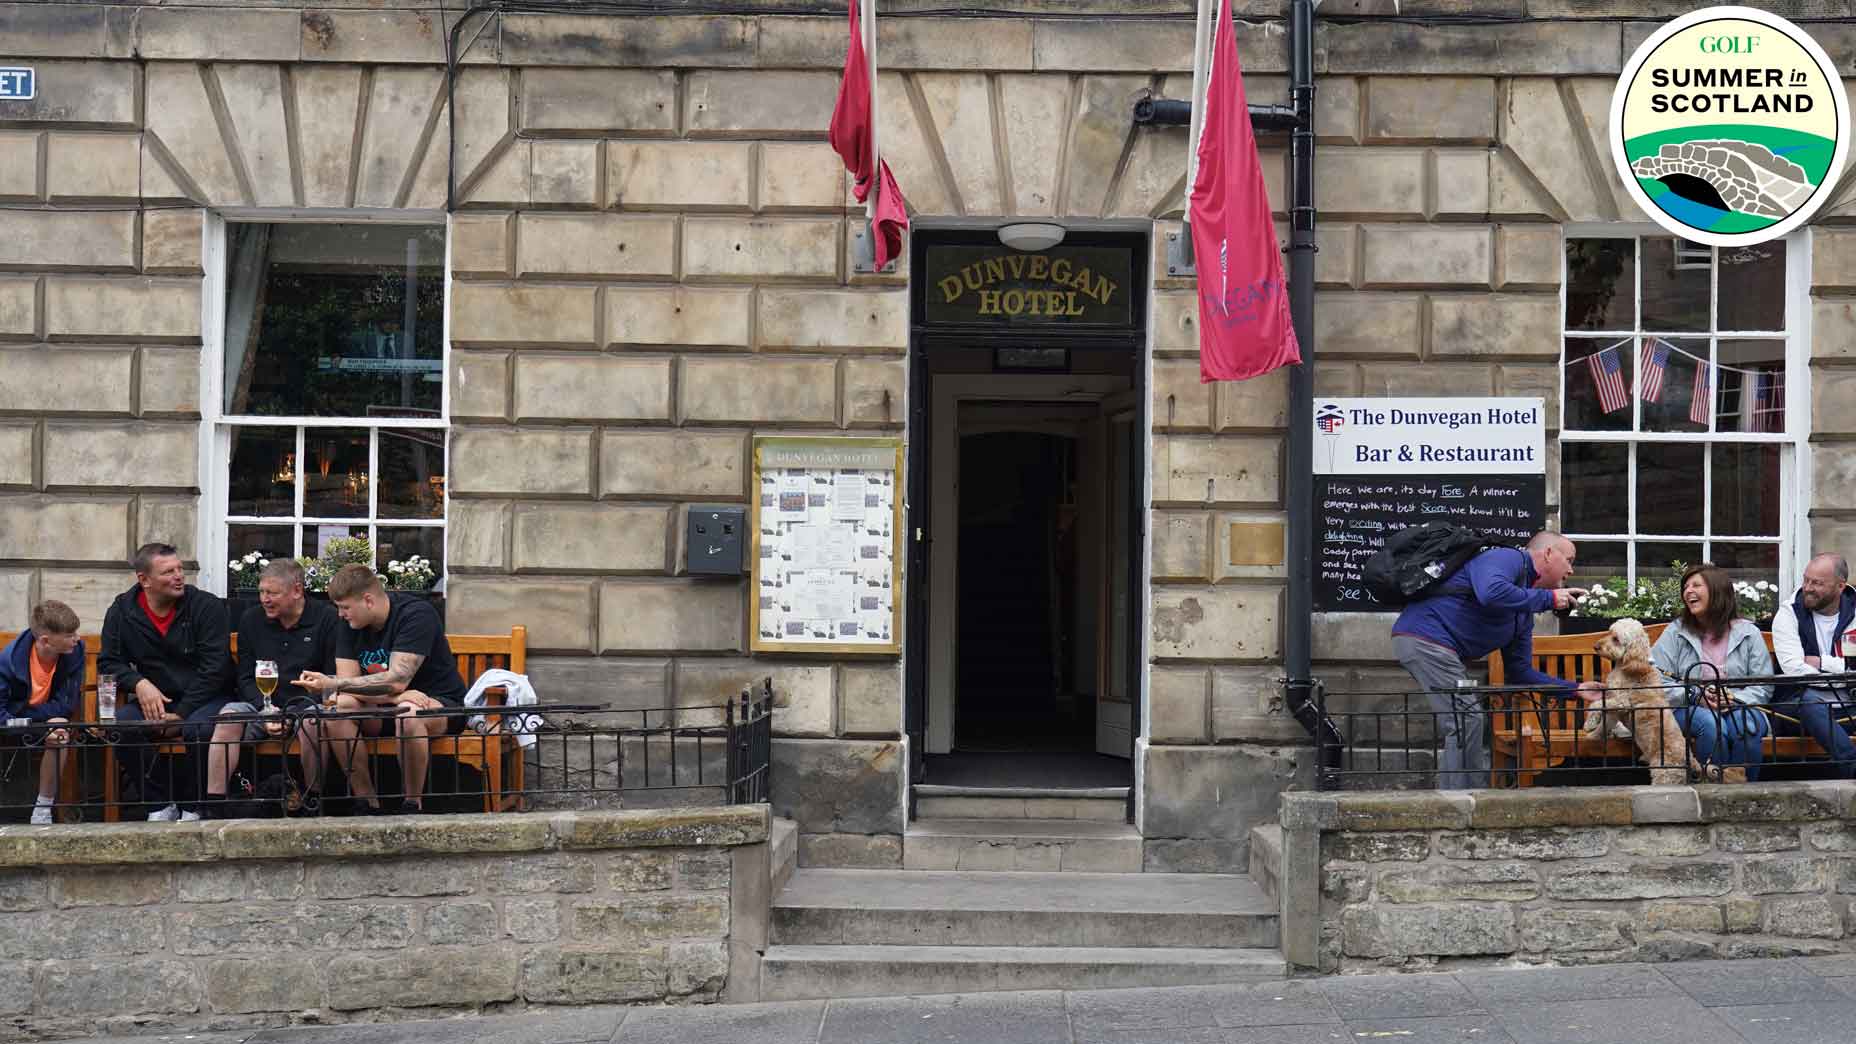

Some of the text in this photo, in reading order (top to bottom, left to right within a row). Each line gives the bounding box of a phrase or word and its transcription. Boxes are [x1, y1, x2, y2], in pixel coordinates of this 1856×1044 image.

[937, 255, 1118, 305] DUNVEGAN
[977, 289, 1086, 316] HOTEL
[1350, 407, 1537, 429] The Dunvegan Hotel
[1356, 444, 1535, 462] Bar & Restaurant
[1327, 483, 1353, 495] Here
[1418, 483, 1437, 499] day
[1469, 485, 1478, 496] A
[1483, 487, 1519, 497] winner
[1323, 501, 1358, 512] emerges
[1396, 502, 1416, 513] best
[1517, 508, 1531, 518] be
[1337, 586, 1361, 601] See
